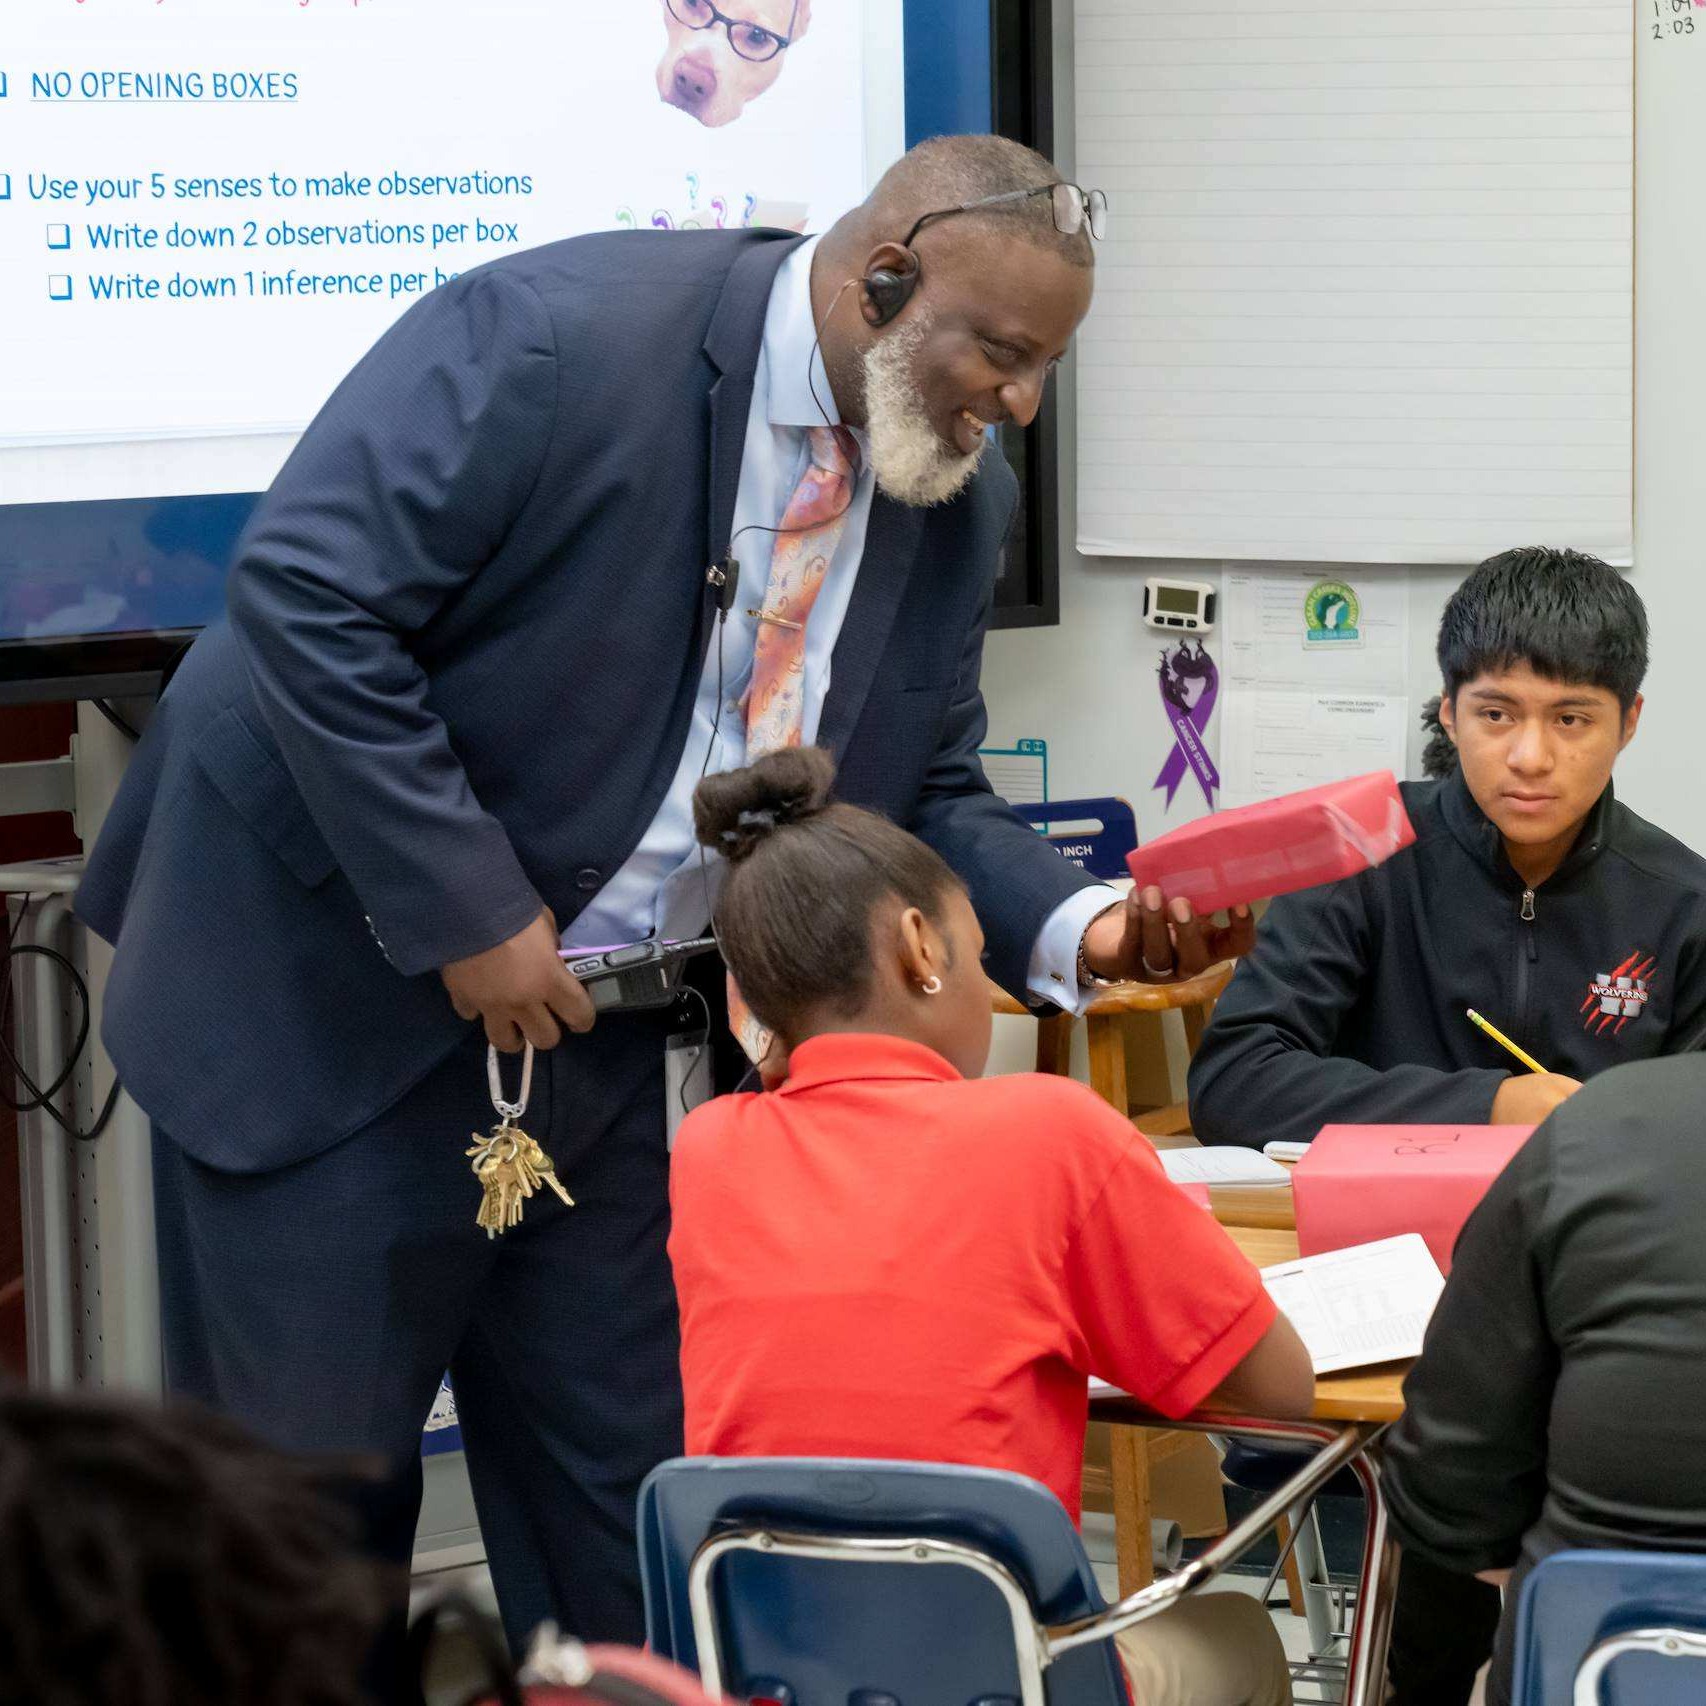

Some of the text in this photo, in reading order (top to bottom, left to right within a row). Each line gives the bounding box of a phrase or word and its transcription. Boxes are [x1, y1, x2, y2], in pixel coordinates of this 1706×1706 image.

[1652, 16, 1695, 40] 2:03
[32, 71, 299, 98] NO OPENING BOXES
[28, 170, 533, 206] Use your 5 senses to make observations
[87, 217, 519, 250] Write down 2 observations per box
[88, 273, 161, 300] Write
[167, 271, 236, 298] down
[244, 270, 255, 296] 1
[262, 268, 384, 297] inference
[390, 272, 428, 299] per
[1062, 845, 1093, 857] INCH
